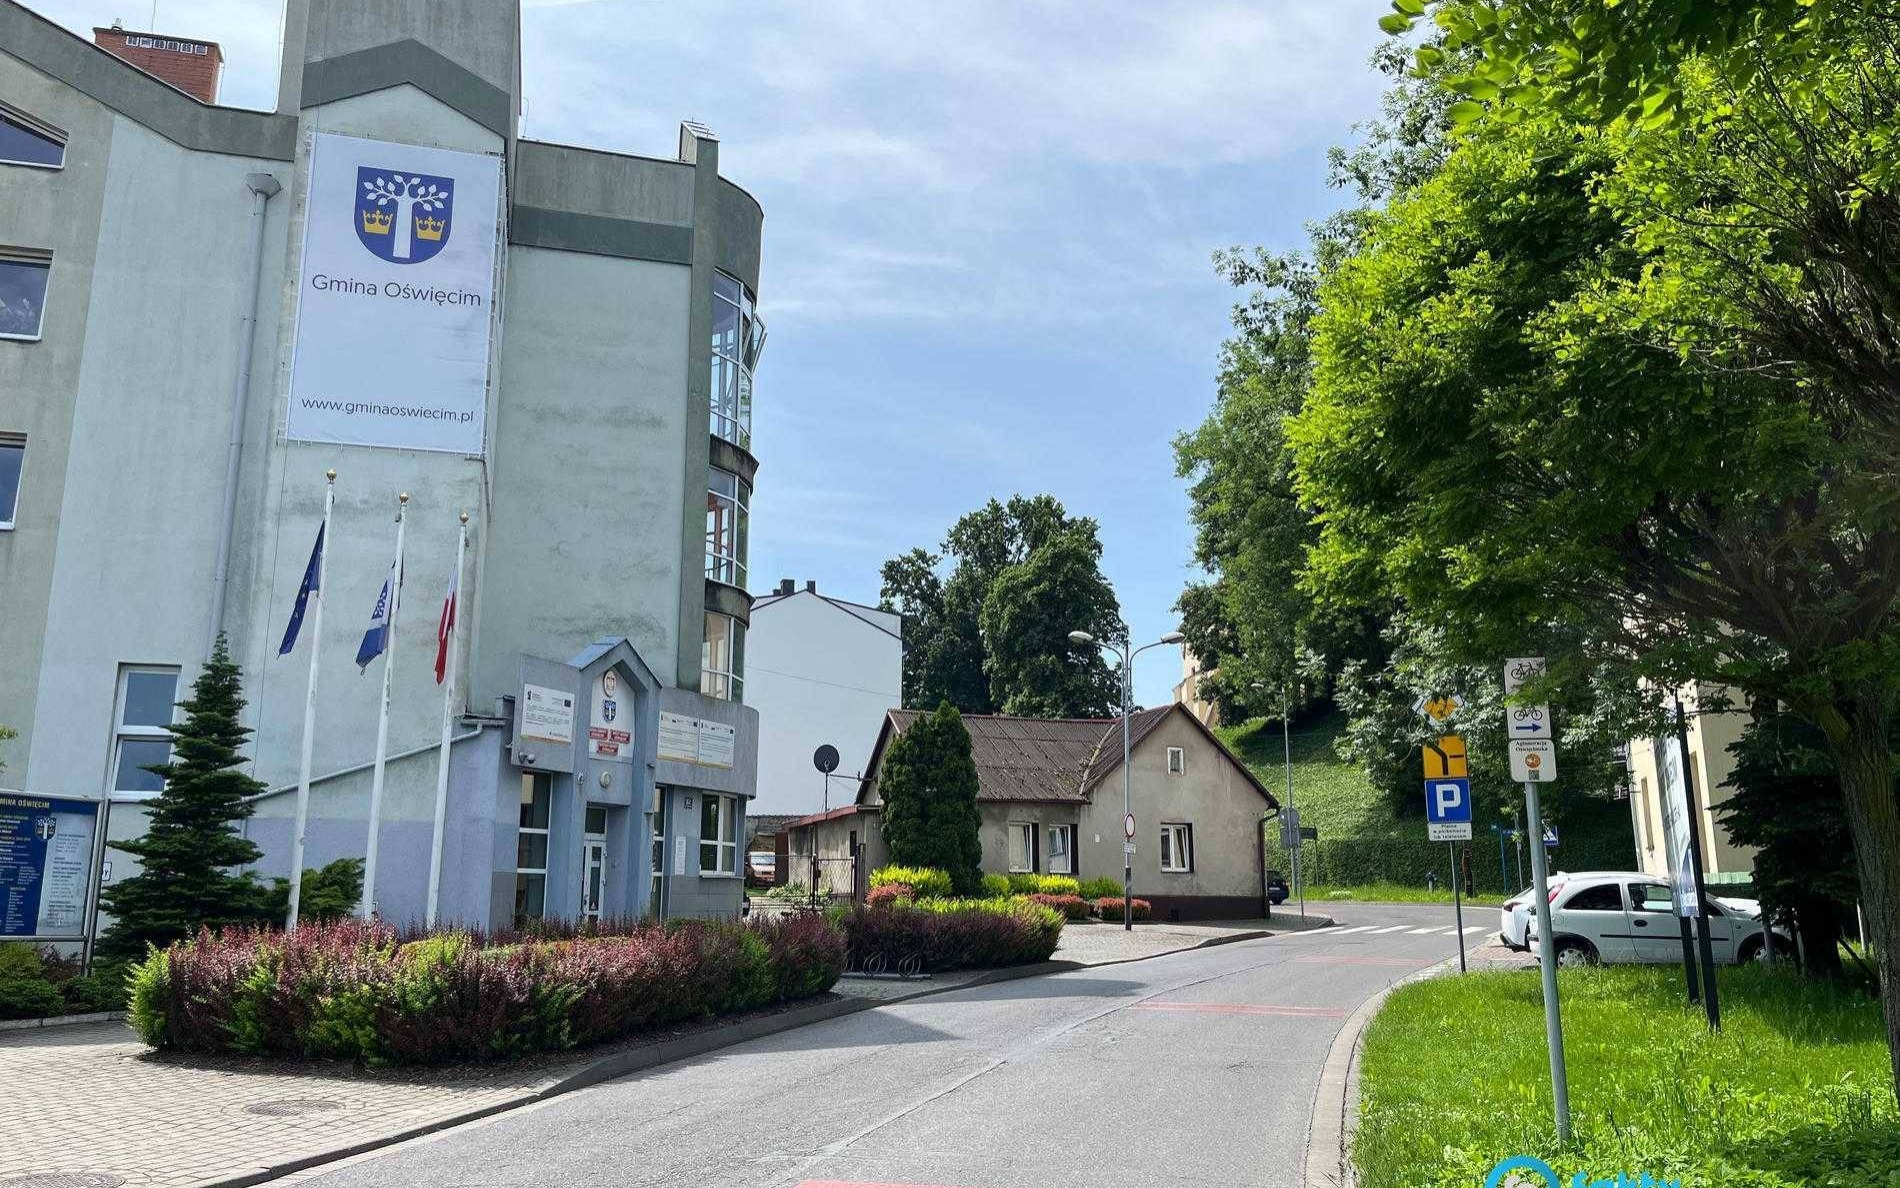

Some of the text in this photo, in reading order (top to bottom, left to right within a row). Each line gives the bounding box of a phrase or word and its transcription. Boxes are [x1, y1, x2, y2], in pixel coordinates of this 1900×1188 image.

[312, 274, 481, 306] Gmina Oświęcim
[301, 398, 474, 423] www.gminaoswiecim.pl
[1436, 784, 1461, 817] P
